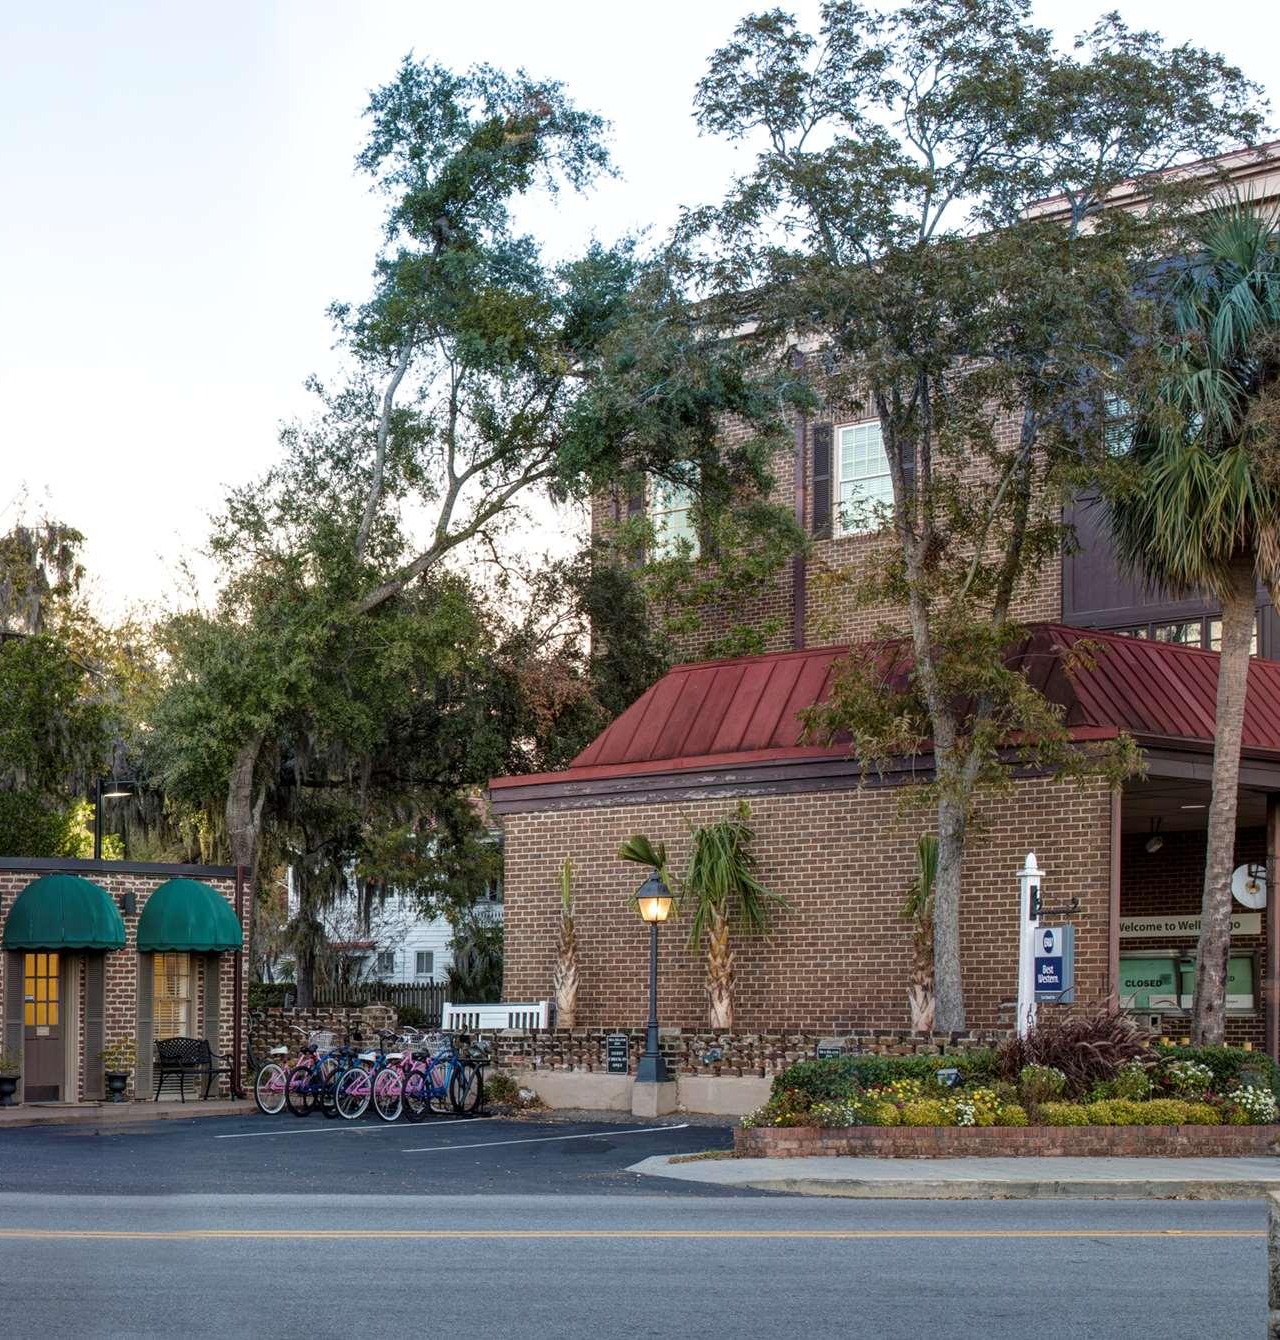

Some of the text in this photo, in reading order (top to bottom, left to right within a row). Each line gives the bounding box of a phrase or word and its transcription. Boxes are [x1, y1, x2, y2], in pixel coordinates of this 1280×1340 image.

[1165, 922, 1176, 931] to
[1178, 919, 1201, 931] Well
[1042, 964, 1054, 974] Best
[1125, 979, 1162, 988] CLOSED
